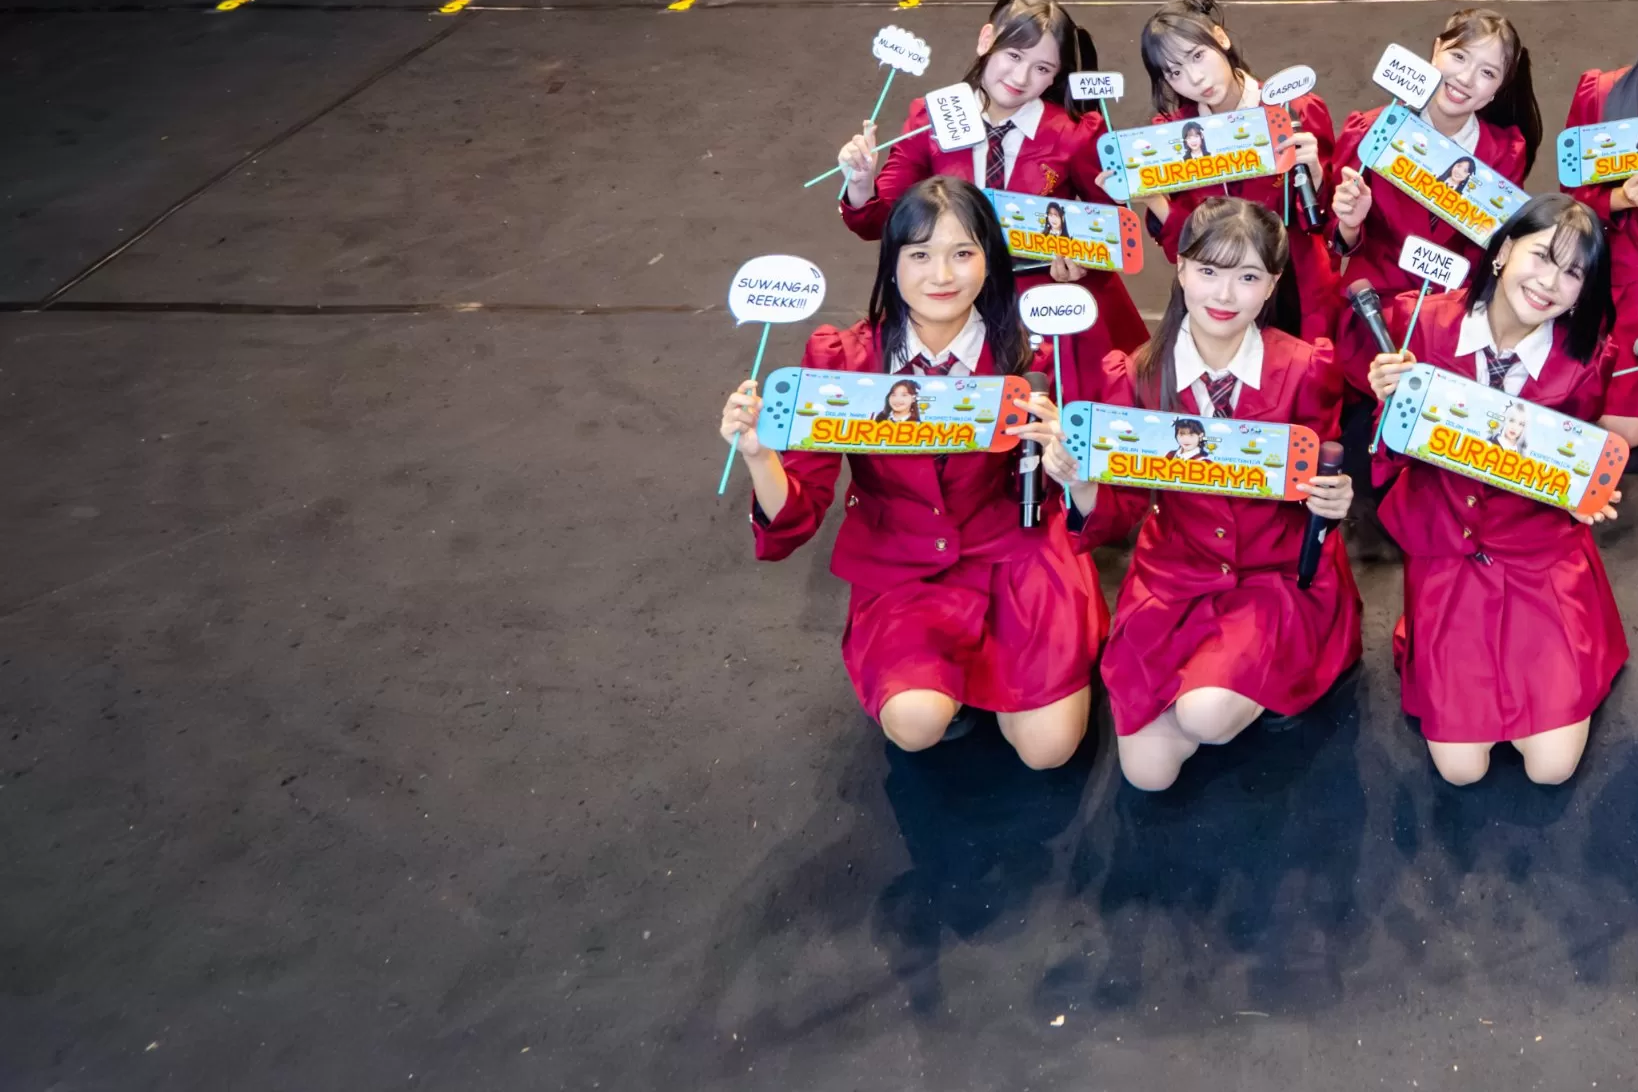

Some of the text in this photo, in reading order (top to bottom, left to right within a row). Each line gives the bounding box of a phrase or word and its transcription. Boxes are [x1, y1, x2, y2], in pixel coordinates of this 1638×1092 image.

[879, 38, 906, 56] MLAKU
[1080, 76, 1111, 86] AYUNE
[1382, 69, 1426, 97] SUWUN!
[1389, 58, 1427, 85] MATUR
[1080, 87, 1115, 96] TALAH!
[937, 97, 961, 142] SUWUN!
[950, 95, 971, 134] MATUR
[1138, 148, 1262, 189] SURABAYA
[1390, 155, 1498, 236] SURABAYA
[1008, 229, 1111, 266] SURABAYA
[1413, 246, 1454, 269] AYUNE
[1411, 257, 1451, 283] TALAH!
[738, 278, 820, 294] SUWANGAR
[746, 294, 808, 309] REEKKK!!!
[1030, 304, 1086, 318] MONGGO!
[811, 417, 976, 447] SURABAYA
[1108, 451, 1268, 490] SURABAYA
[1428, 423, 1573, 497] SURABAYA
